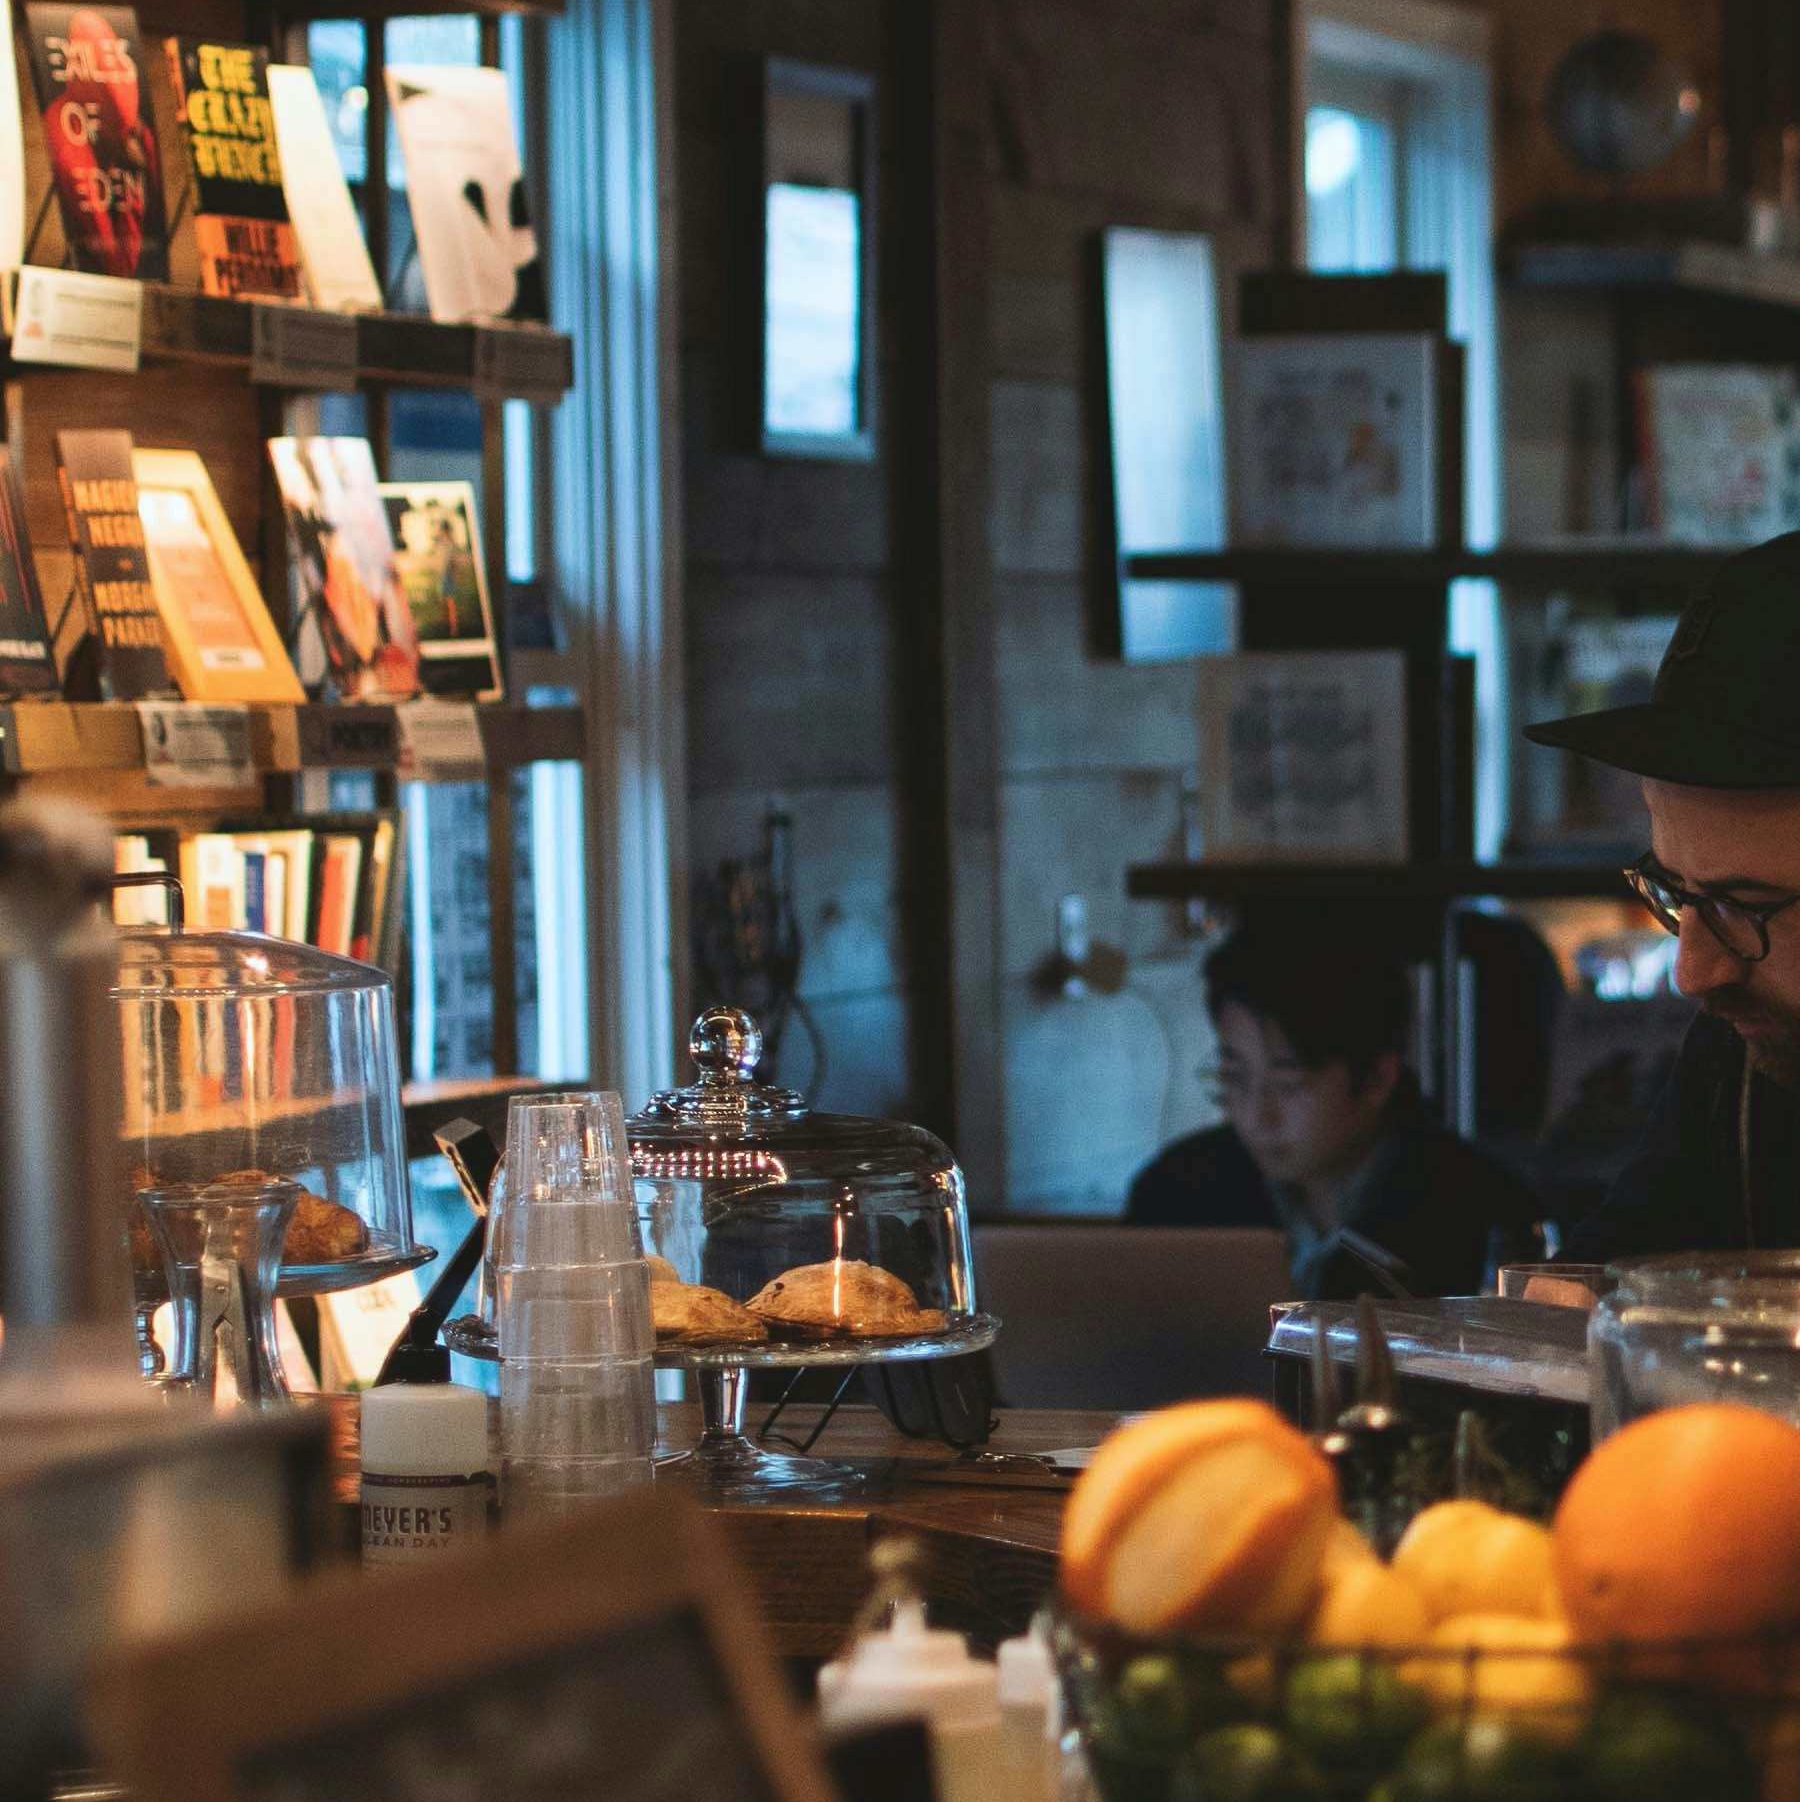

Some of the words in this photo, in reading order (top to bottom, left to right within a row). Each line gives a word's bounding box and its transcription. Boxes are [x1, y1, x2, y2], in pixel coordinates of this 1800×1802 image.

[44, 36, 139, 85] EXILES
[60, 100, 101, 147] OF
[71, 165, 145, 215] EDEN
[361, 1505, 452, 1534] MEYER'S
[412, 1538, 449, 1549] DAY
